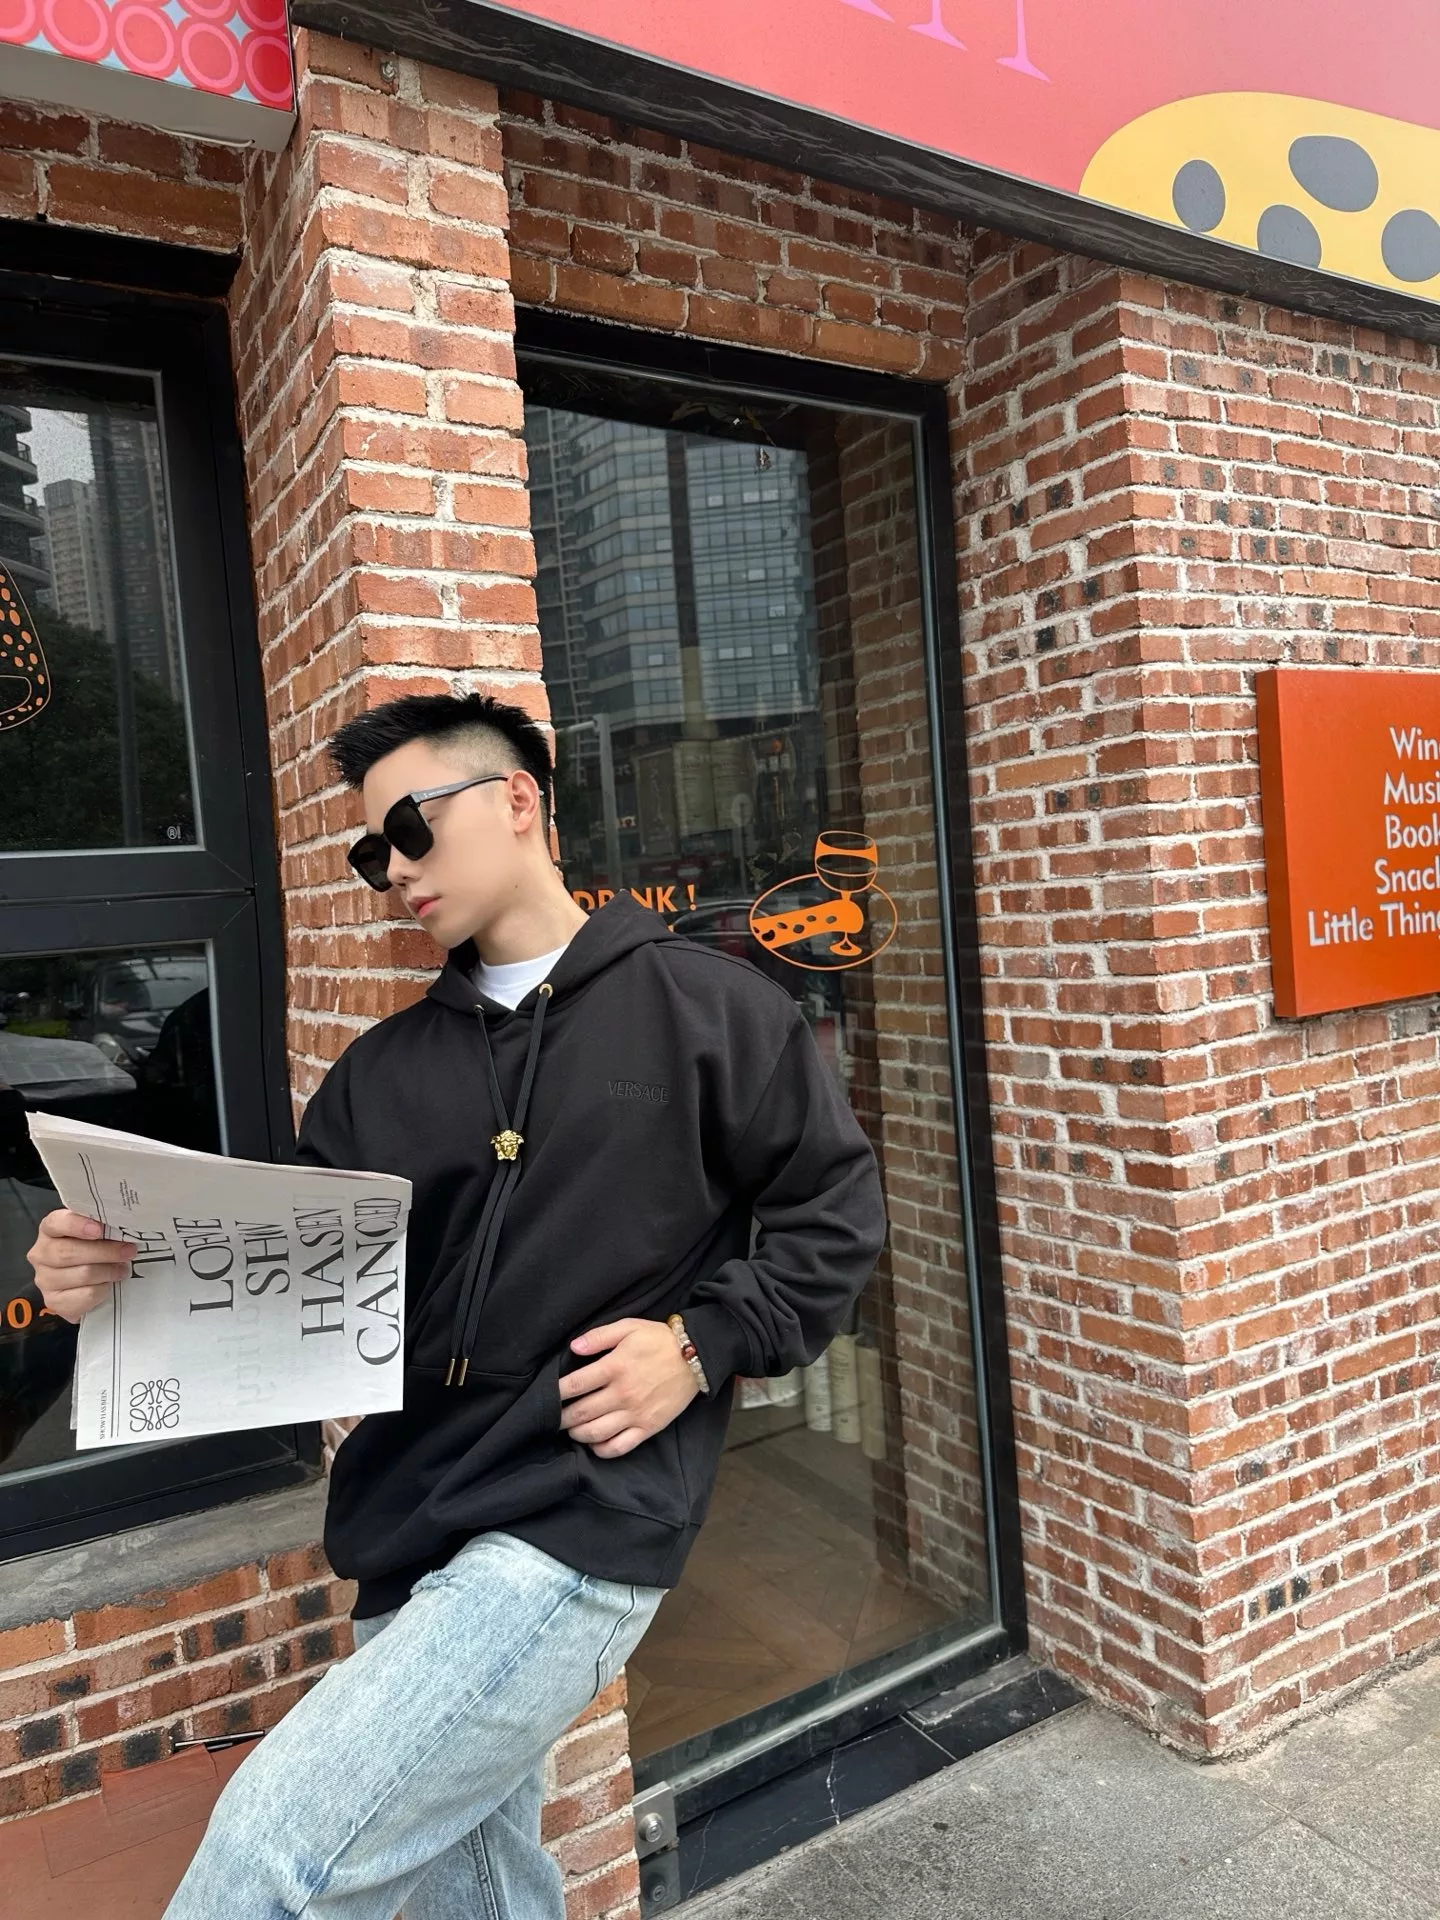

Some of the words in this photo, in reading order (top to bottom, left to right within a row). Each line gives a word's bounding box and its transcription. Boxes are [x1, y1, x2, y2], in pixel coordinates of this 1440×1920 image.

[1390, 727, 1440, 760] Win
[572, 886, 678, 912] DRNK
[1308, 906, 1373, 947] Little
[608, 1080, 669, 1103] VERSACE
